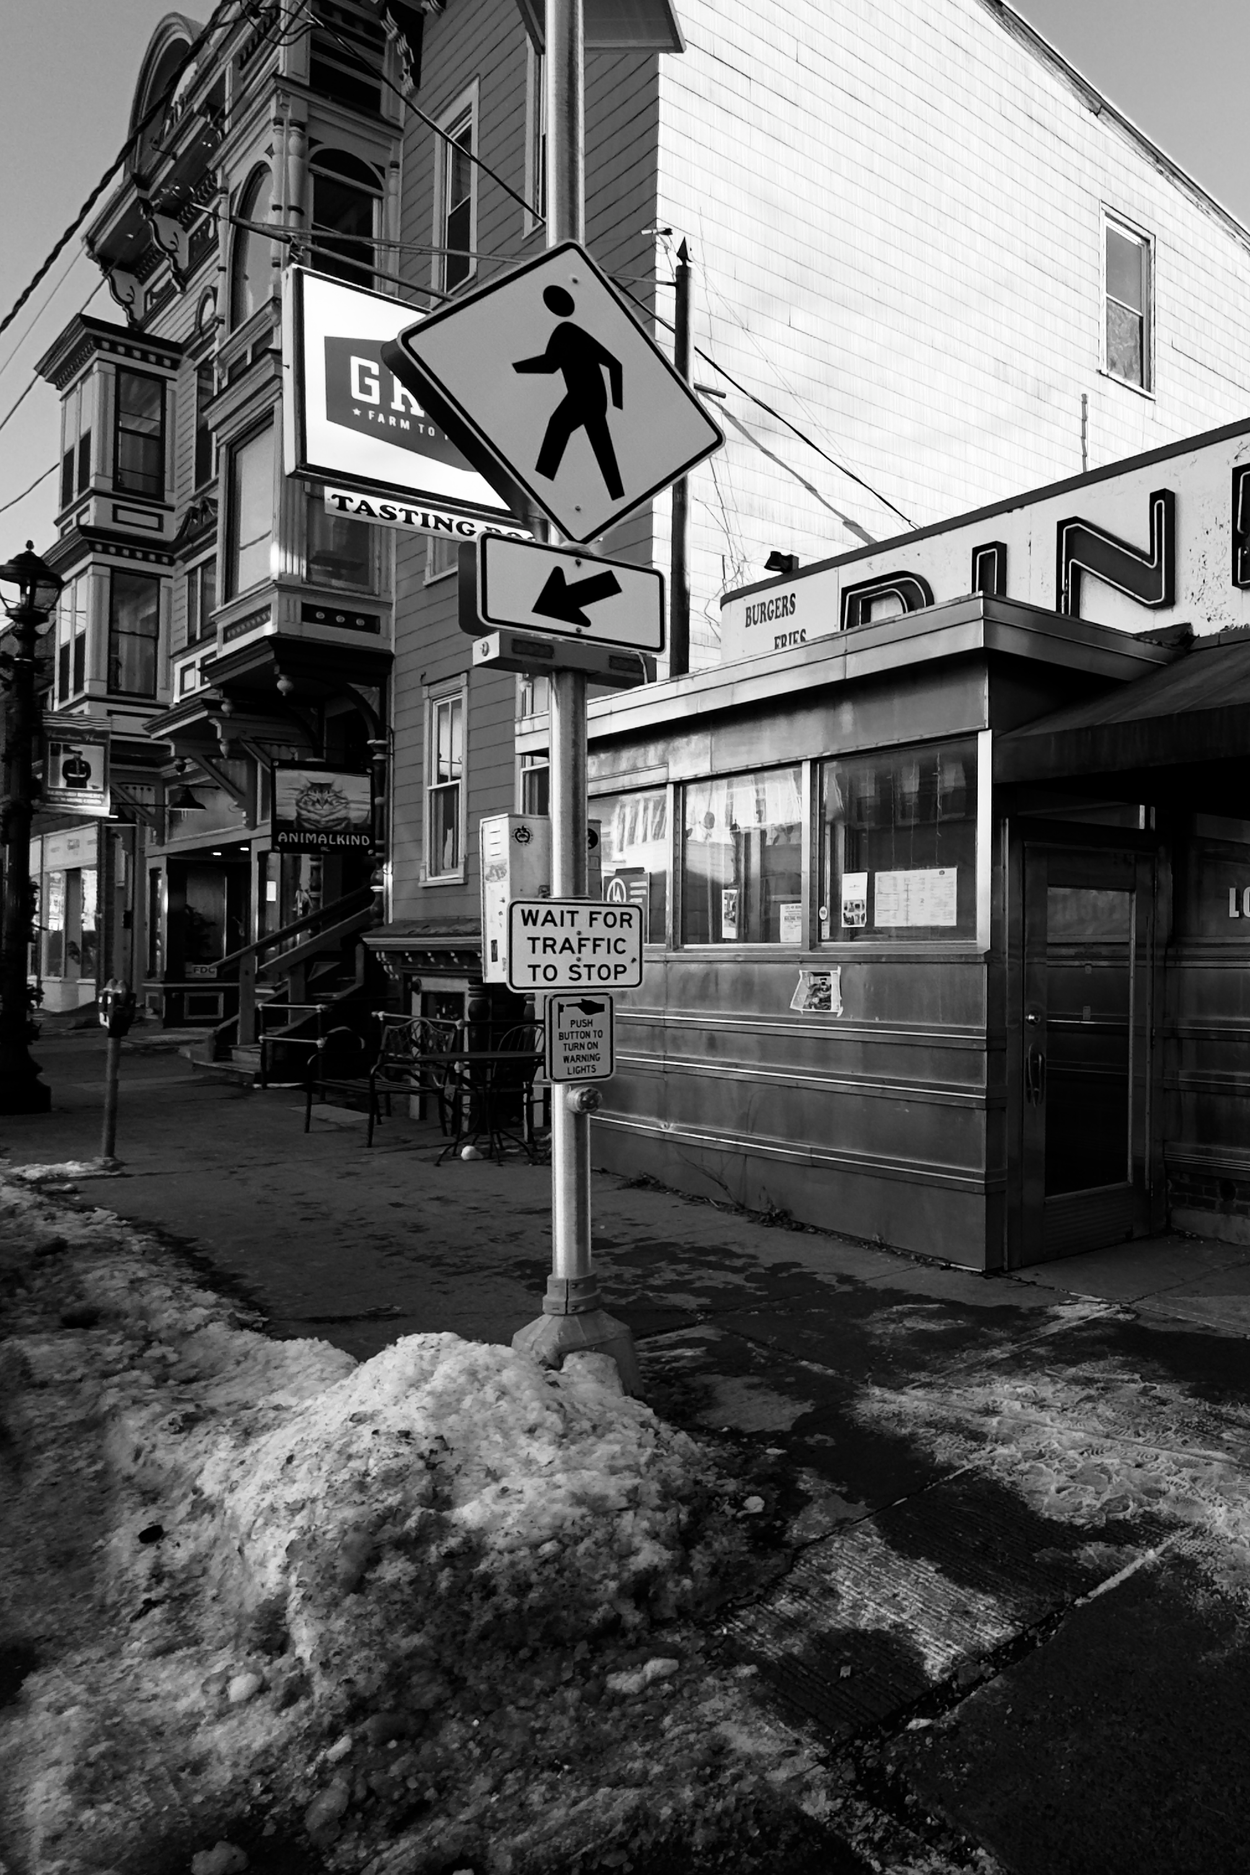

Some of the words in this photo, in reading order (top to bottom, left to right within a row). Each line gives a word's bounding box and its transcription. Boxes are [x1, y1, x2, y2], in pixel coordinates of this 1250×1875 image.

[368, 410, 411, 430] FARM
[418, 423, 436, 437] TO
[331, 494, 477, 537] TASTING
[745, 592, 797, 628] BURGERS
[277, 831, 370, 846] ANIMALKIND
[520, 909, 579, 928] WAIT
[589, 910, 633, 929] FOR
[526, 936, 627, 955] TRAFFIC
[527, 964, 558, 982] TO
[568, 964, 627, 982] STOP
[570, 1019, 594, 1028] PUSH
[558, 1030, 591, 1041] BUTTON
[593, 1029, 604, 1039] TO
[563, 1042, 586, 1052] TURN
[587, 1041, 599, 1051] ON
[563, 1053, 602, 1064] WARNING
[567, 1064, 597, 1076] LIGHTS
